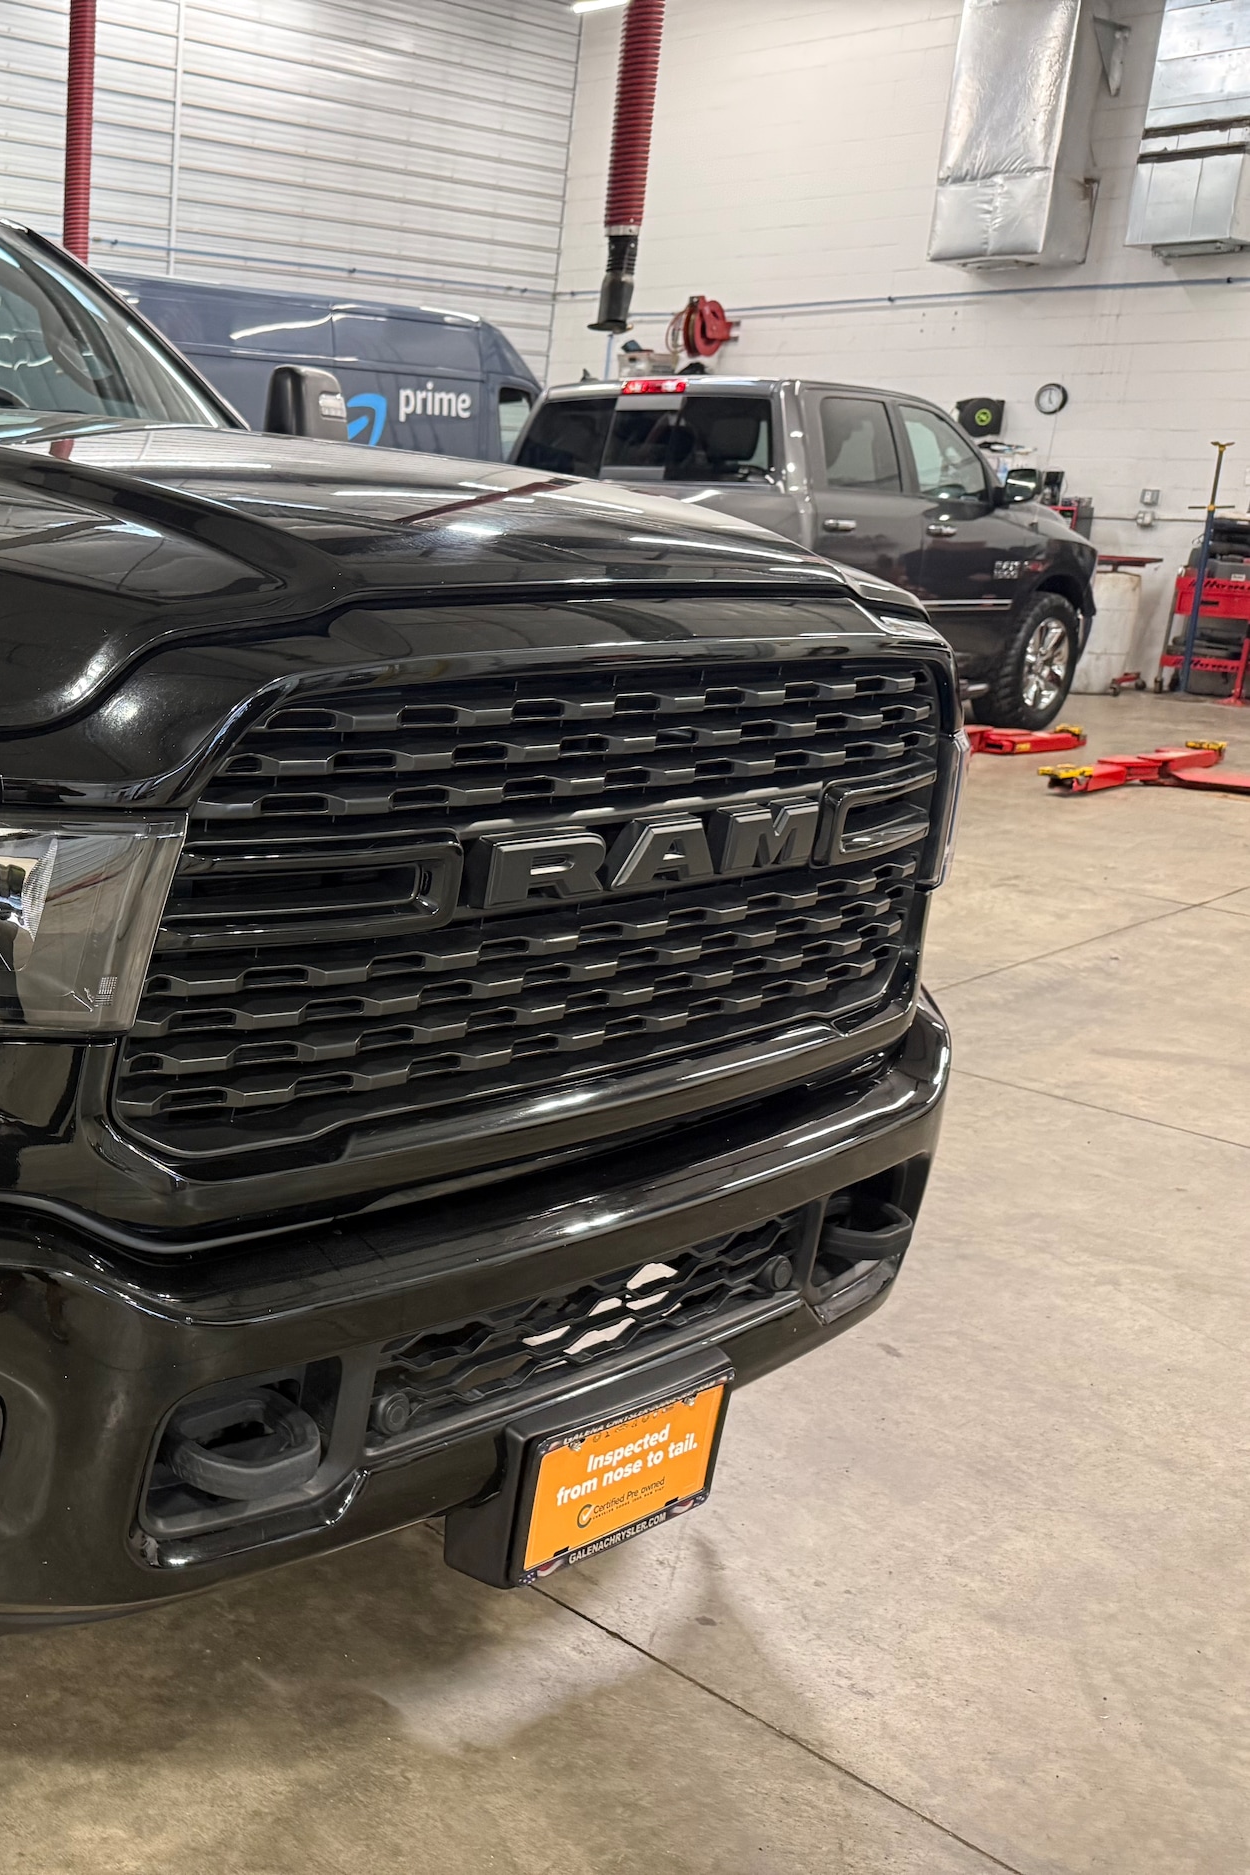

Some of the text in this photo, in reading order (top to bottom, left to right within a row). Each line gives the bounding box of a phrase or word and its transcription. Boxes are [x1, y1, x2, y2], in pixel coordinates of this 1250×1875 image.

[398, 381, 471, 422] prime
[478, 796, 822, 909] RAM
[556, 1477, 598, 1506] from
[602, 1462, 643, 1487] nose
[646, 1449, 663, 1468] to
[668, 1432, 698, 1459] tail.
[586, 1423, 671, 1473] Inspected
[593, 1493, 626, 1515] Certified
[626, 1489, 639, 1501] Pre
[640, 1476, 666, 1495] owned
[568, 1511, 667, 1565] GALENACHRYSLER.COM
